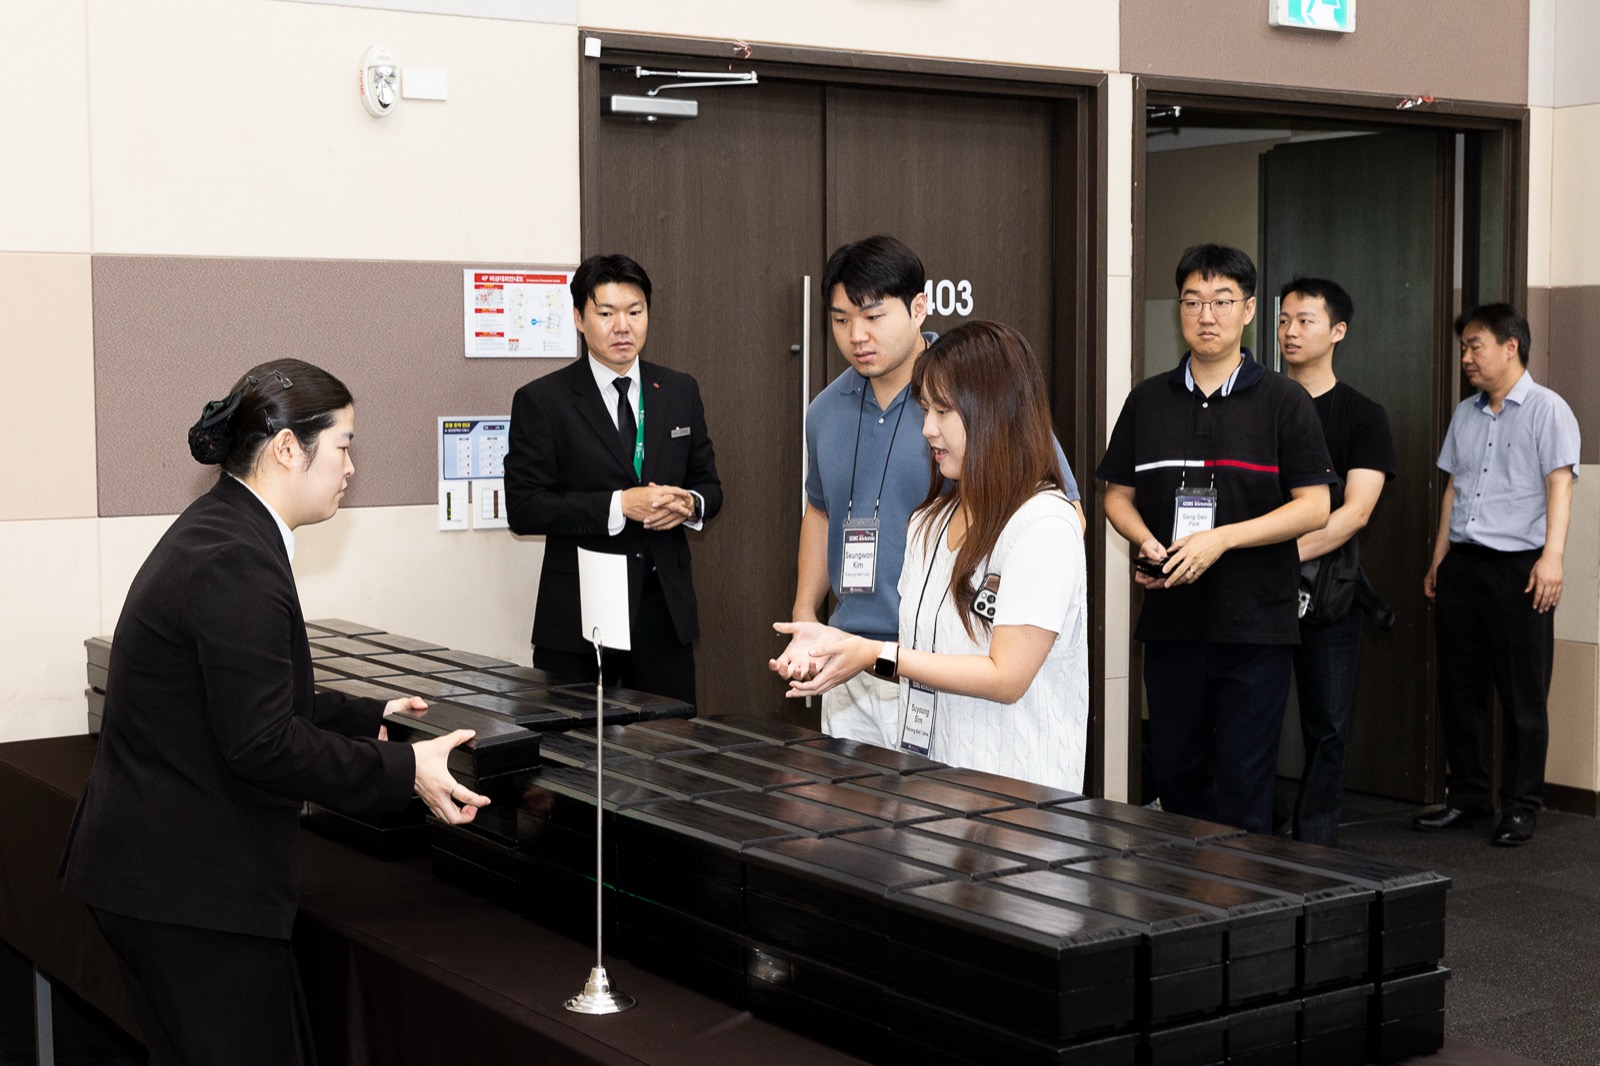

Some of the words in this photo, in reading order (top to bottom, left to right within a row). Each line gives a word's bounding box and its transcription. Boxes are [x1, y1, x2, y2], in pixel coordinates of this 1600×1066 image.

[924, 279, 974, 317] 403
[845, 551, 873, 560] Seungwon
[914, 714, 923, 725] Sim
